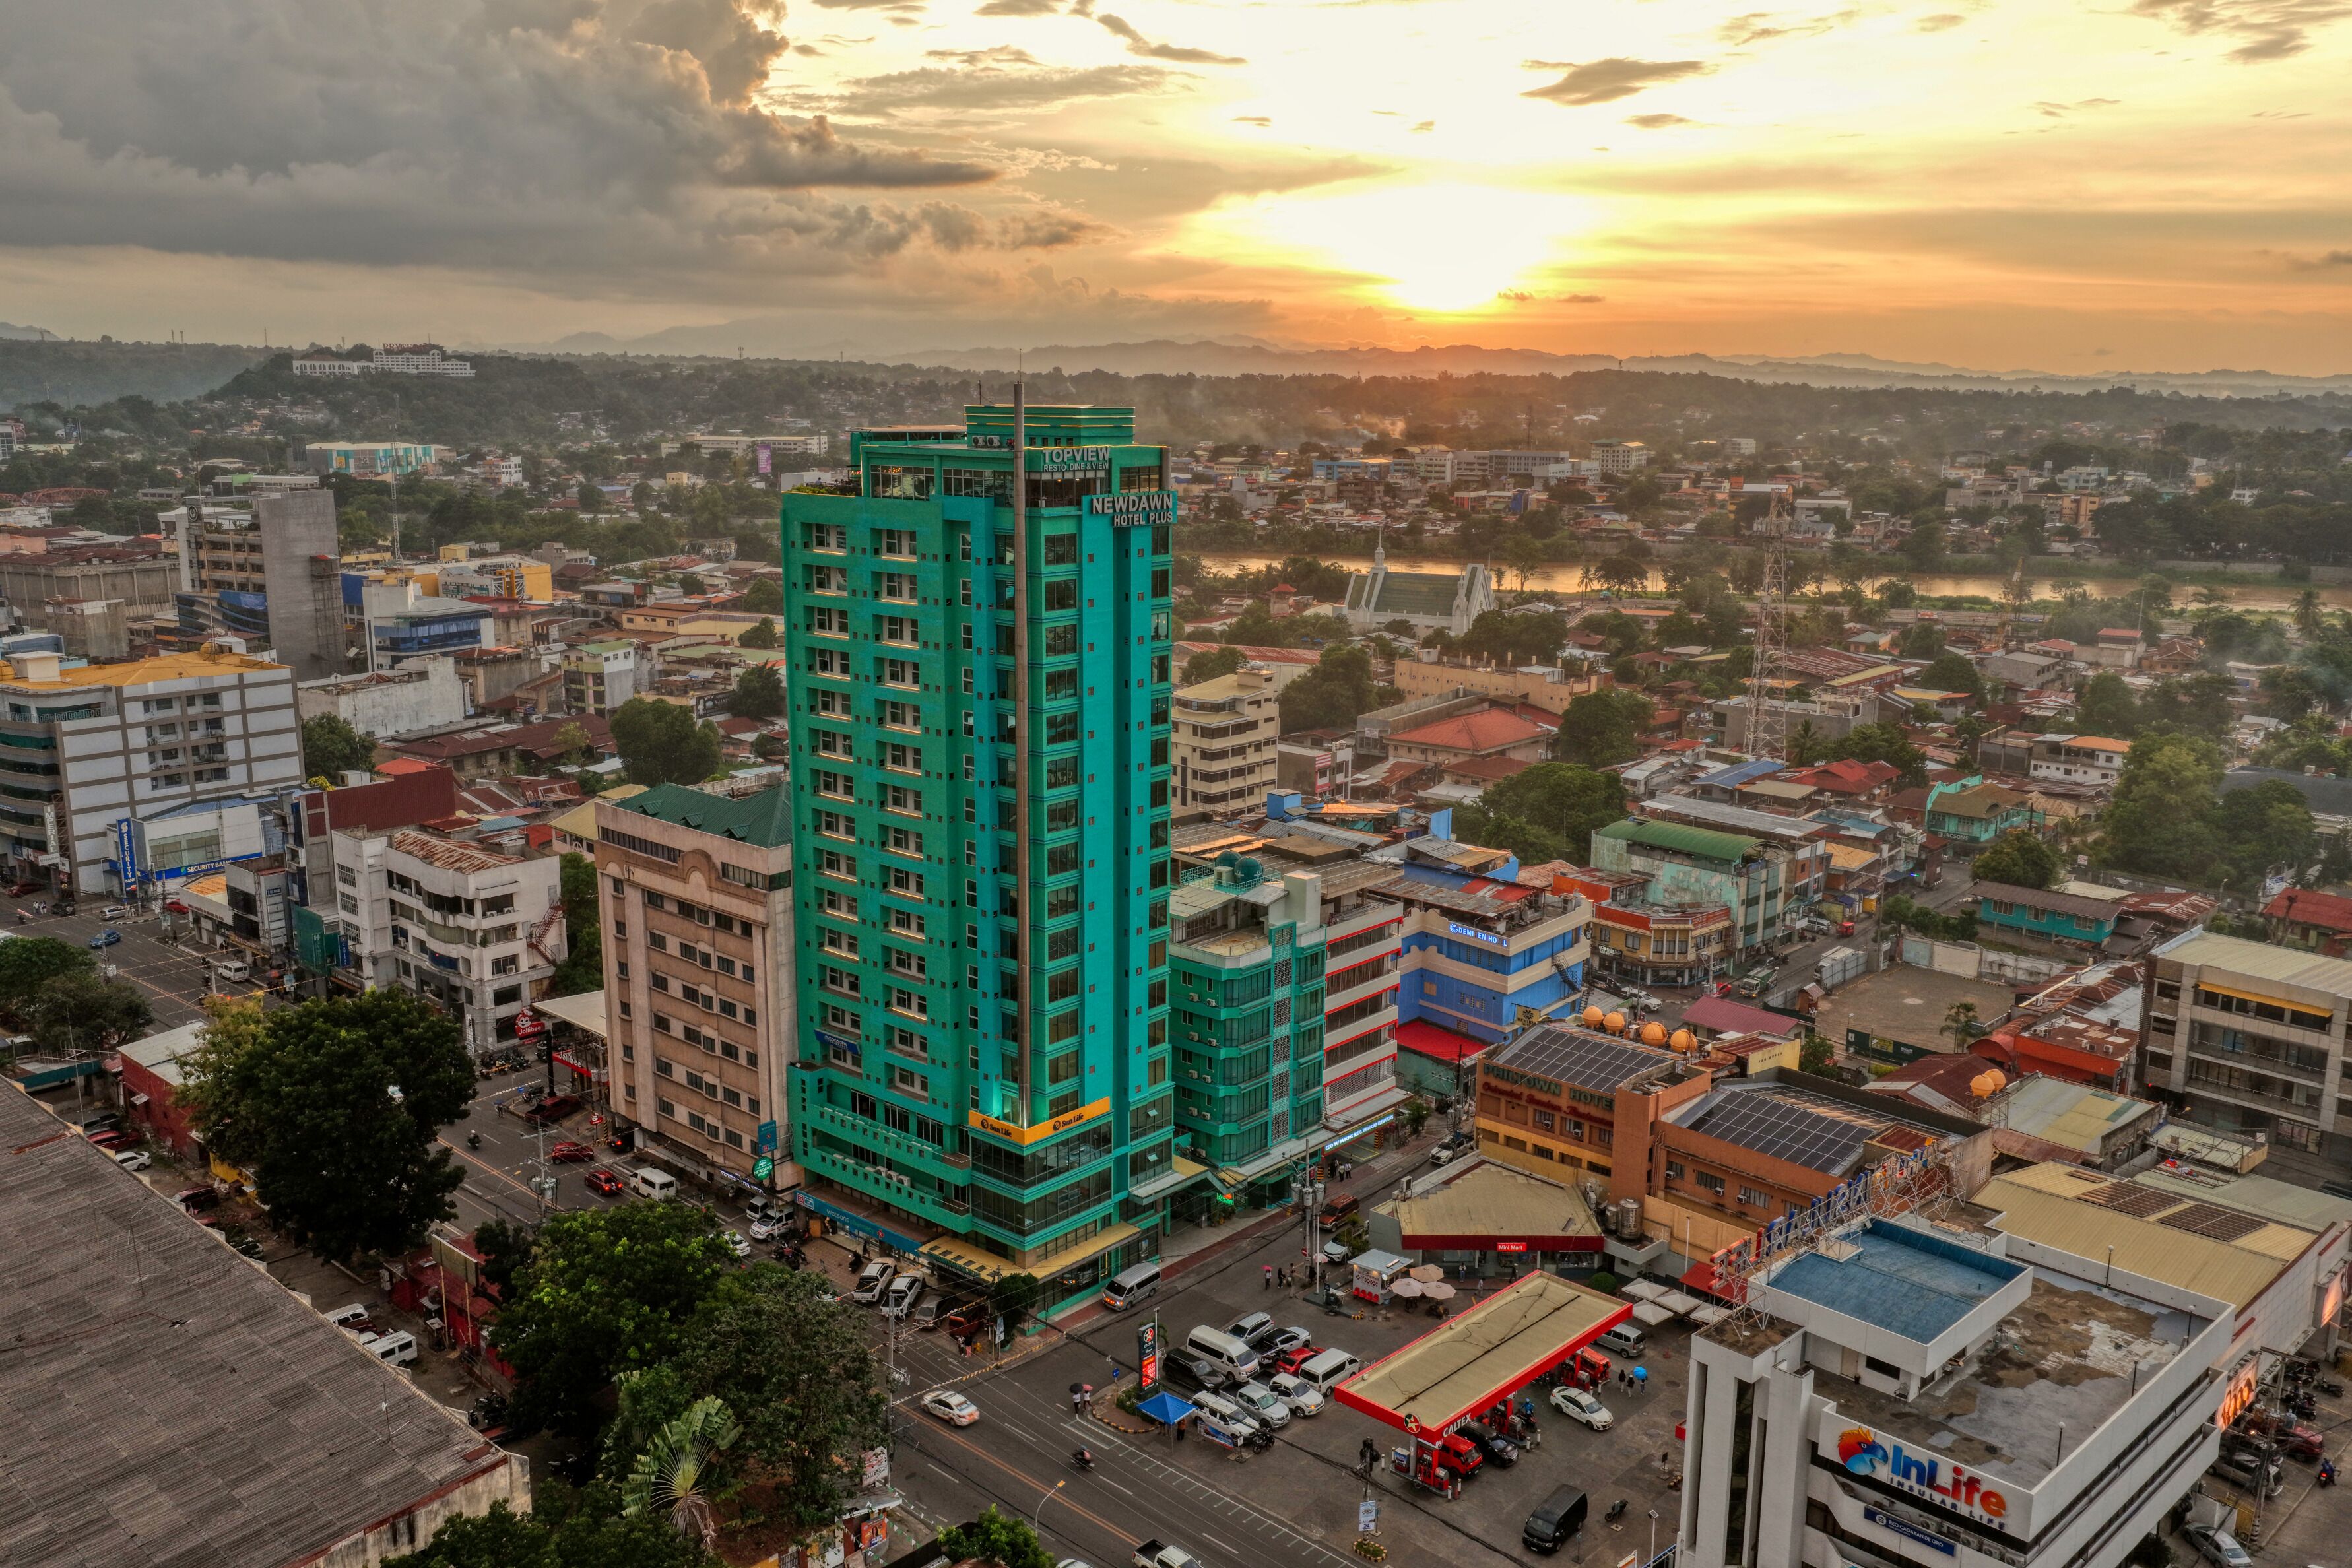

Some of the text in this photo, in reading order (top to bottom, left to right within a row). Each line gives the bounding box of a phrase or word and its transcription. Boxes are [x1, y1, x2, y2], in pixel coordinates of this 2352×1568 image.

[1043, 447, 1110, 463] TOPVIEW
[1092, 494, 1173, 514] NEWDAWN
[1114, 511, 1173, 526] HOTEL PLUS
[46, 806, 57, 853] IMPERIAL
[187, 862, 214, 874] SECURITY
[519, 1026, 541, 1035] Jollibee
[559, 1051, 581, 1068] Jollibee
[1484, 1063, 1562, 1097] PHILTOWN
[1062, 1113, 1084, 1127] Sun Life
[990, 1124, 1012, 1137] Sun Life
[1340, 1134, 1354, 1144] PARKING
[826, 1209, 849, 1222] watsons
[1443, 1412, 1471, 1437] CALTEX
[1891, 1444, 2006, 1517] InLife
[1890, 1477, 2006, 1530] INSULAR LIFE
[1900, 1525, 1924, 1538] CAGAYAN
